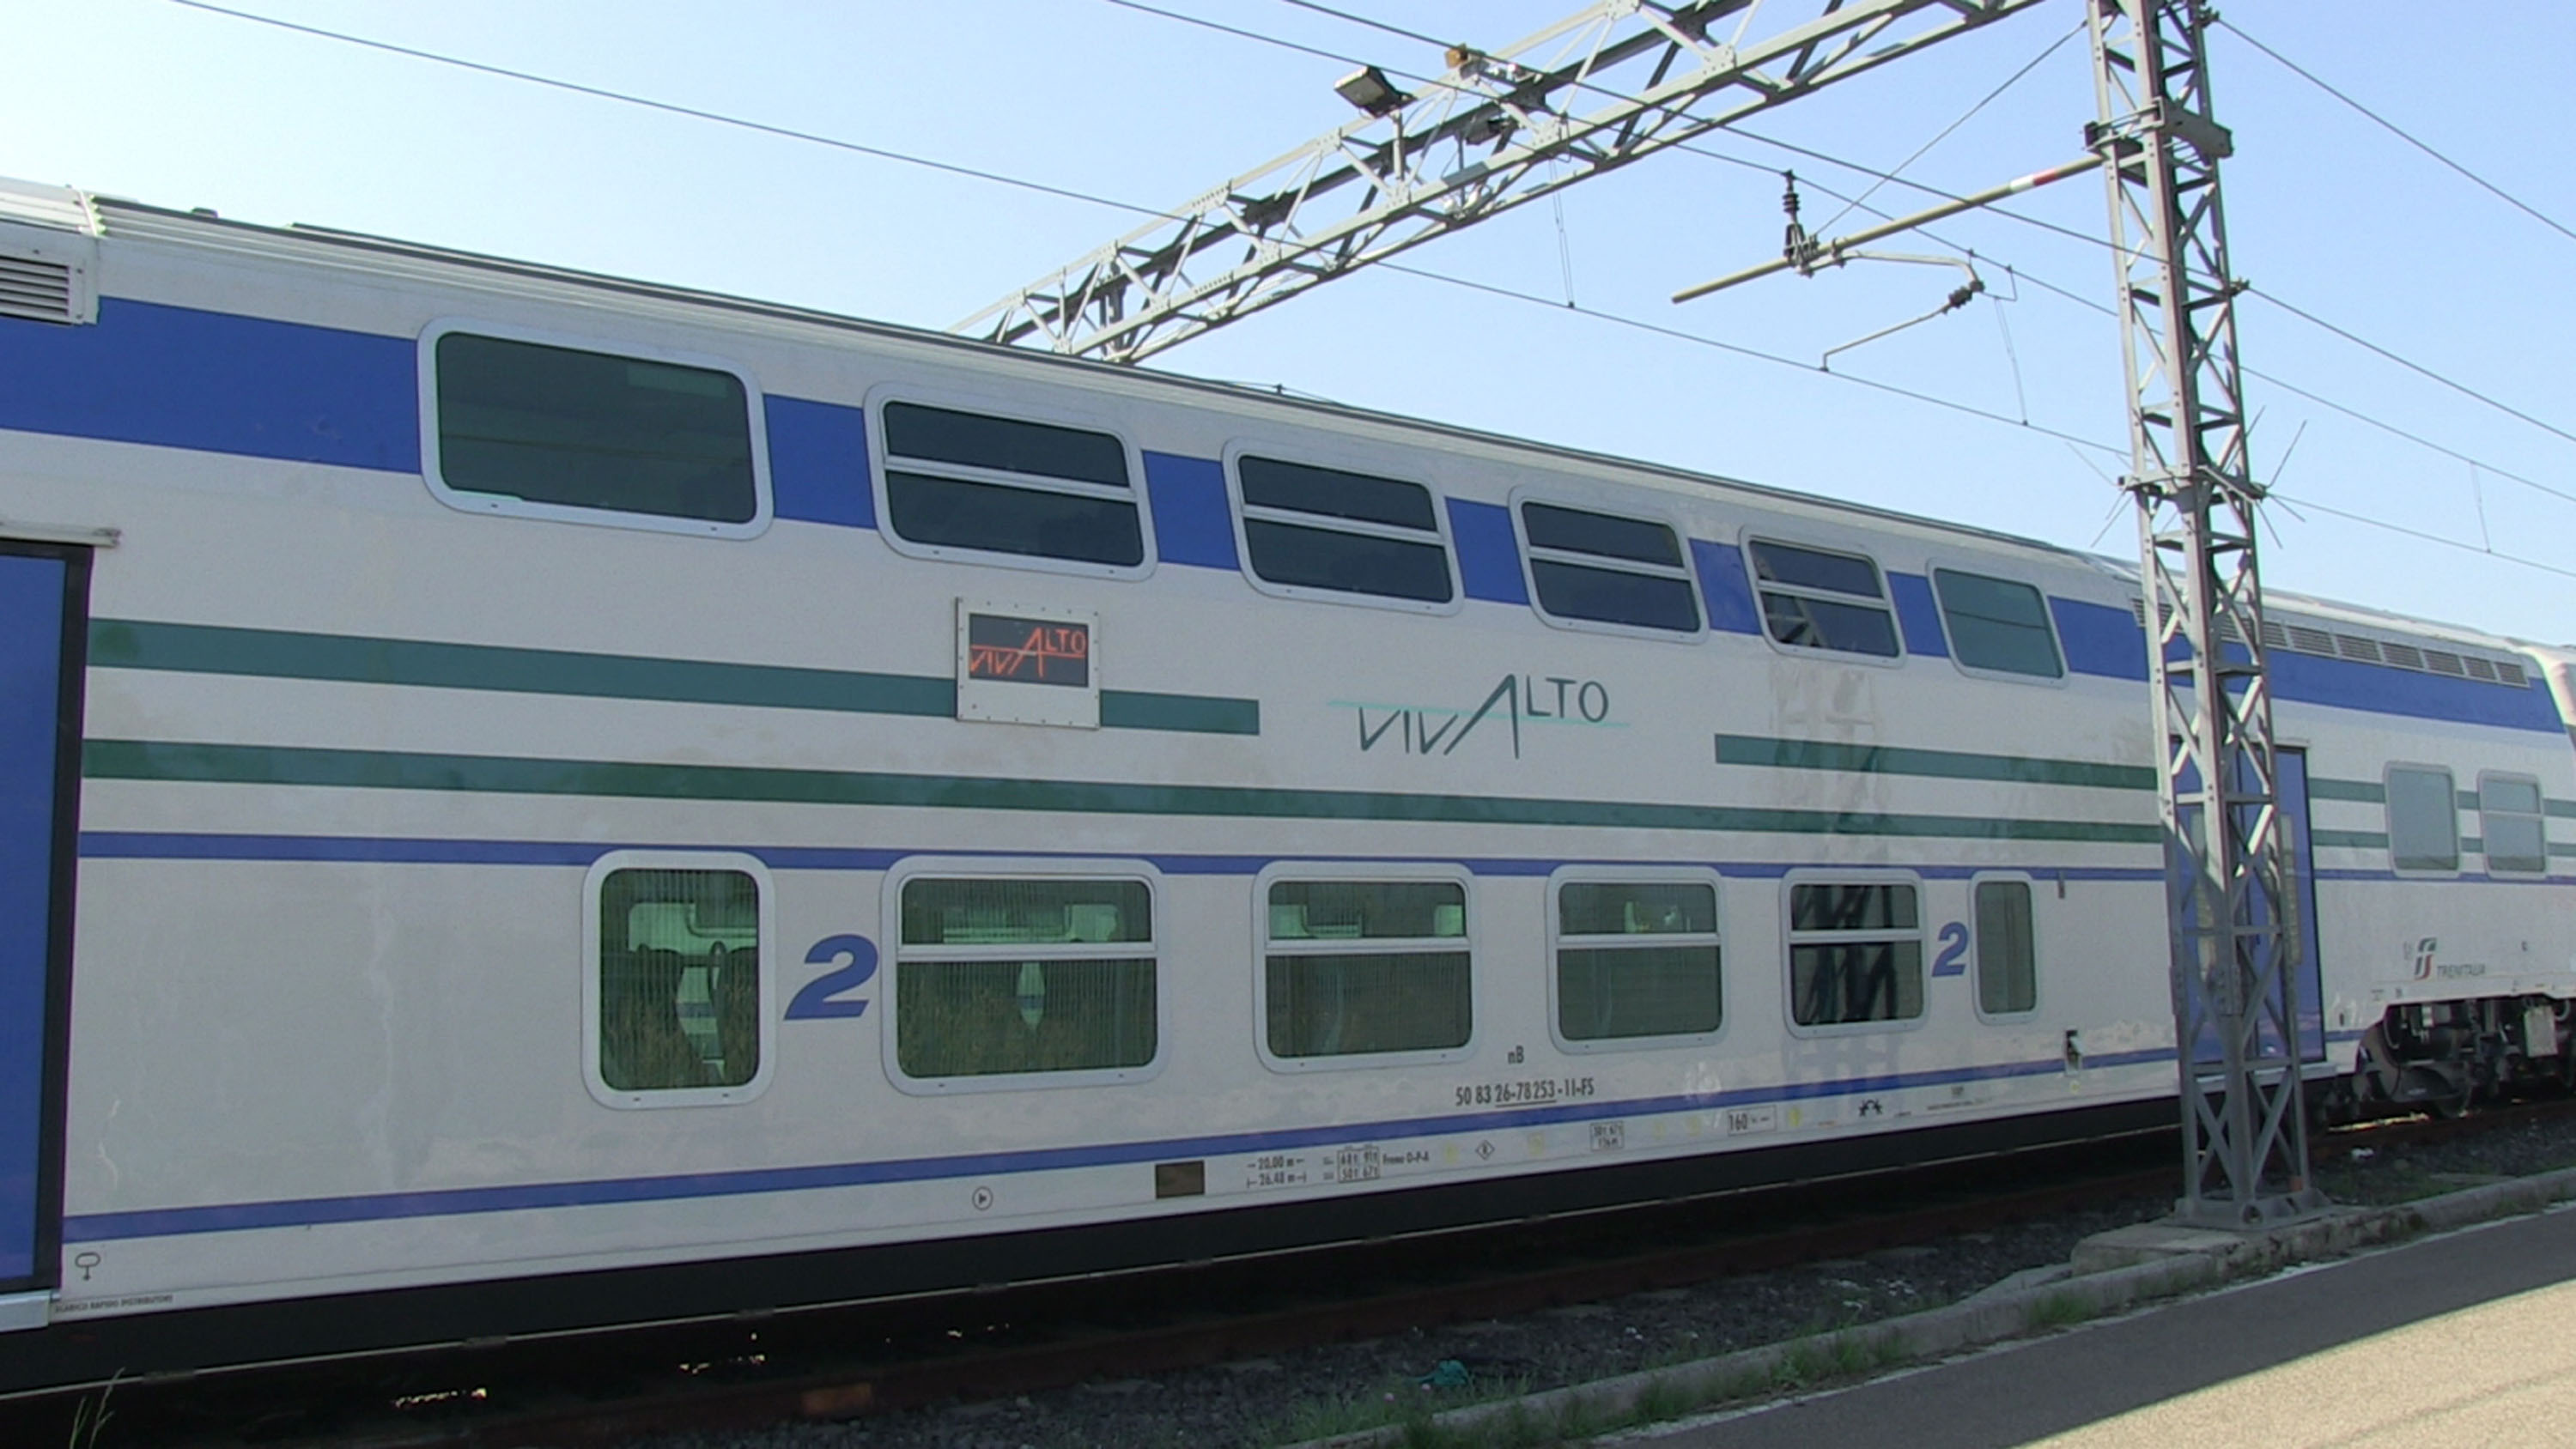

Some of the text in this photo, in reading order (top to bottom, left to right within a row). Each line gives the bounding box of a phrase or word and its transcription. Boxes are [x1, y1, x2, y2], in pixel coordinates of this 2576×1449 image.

[969, 627, 1087, 679] VIVALTO
[1359, 674, 1608, 759] VIVALTO
[1931, 921, 1968, 977] 2
[783, 933, 878, 1021] 2
[1507, 1046, 1524, 1064] nB
[1455, 1087, 1472, 1106] 50
[1475, 1084, 1492, 1105] 83
